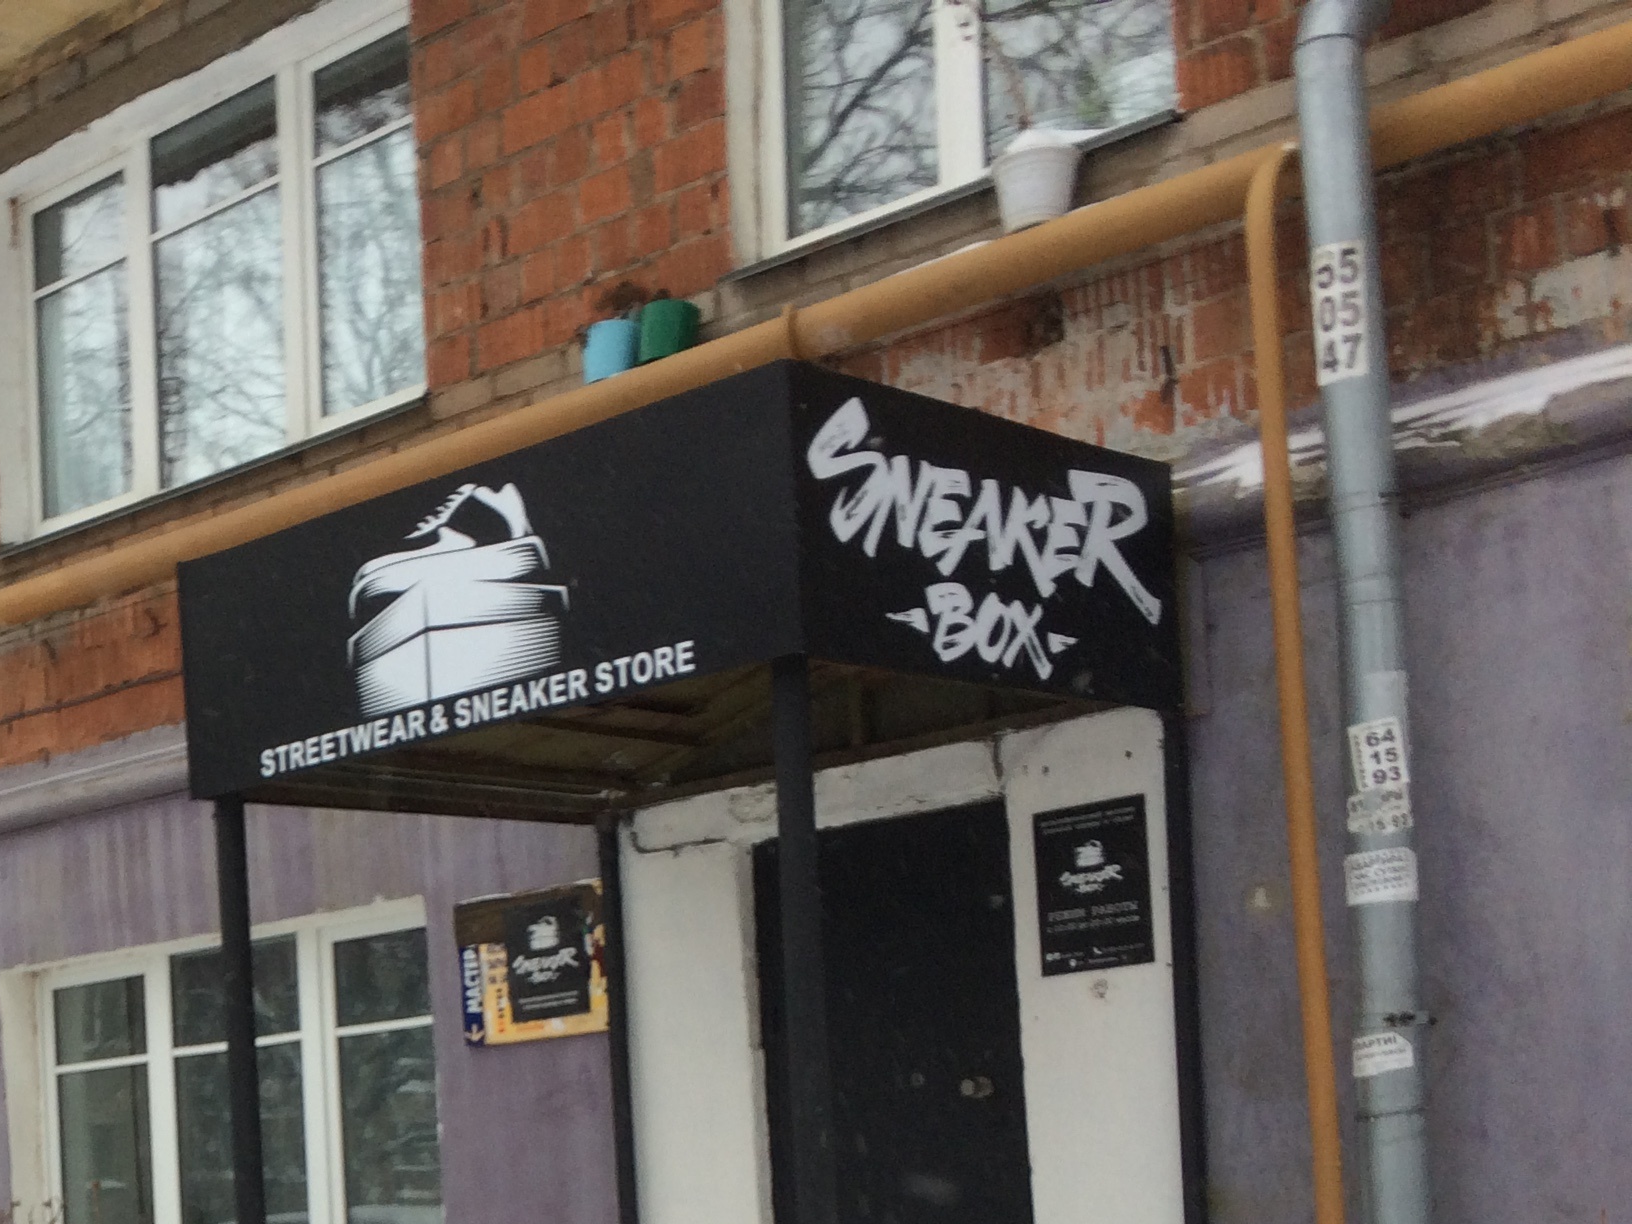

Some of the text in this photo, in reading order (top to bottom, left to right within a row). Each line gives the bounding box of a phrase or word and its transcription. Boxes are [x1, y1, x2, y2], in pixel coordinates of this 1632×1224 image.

[806, 396, 1163, 626] SNEAKER
[924, 582, 1054, 681] BOX
[259, 640, 697, 778] STREETWEAR & SNEAKER STORE
